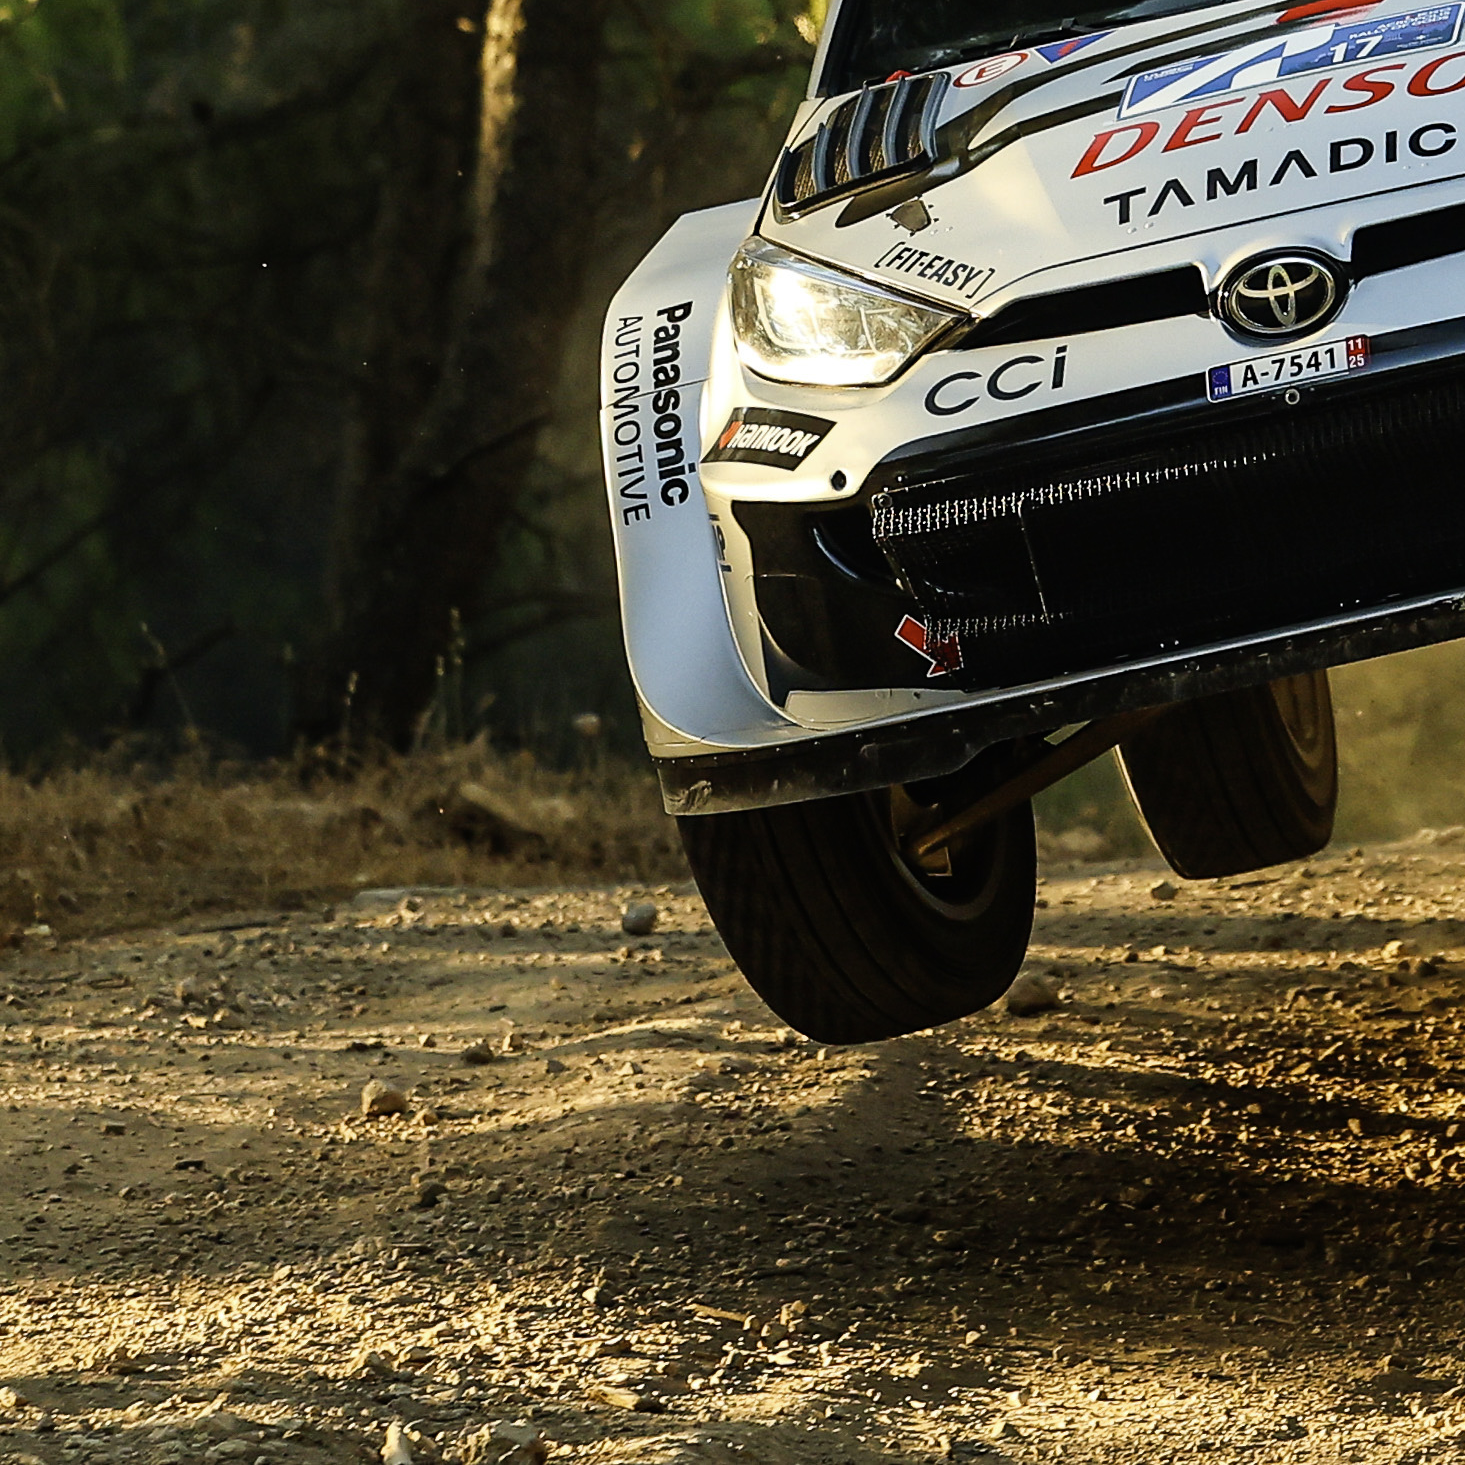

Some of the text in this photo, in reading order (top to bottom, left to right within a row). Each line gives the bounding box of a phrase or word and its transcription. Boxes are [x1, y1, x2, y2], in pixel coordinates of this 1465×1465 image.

[1331, 35, 1382, 63] 17
[1103, 122, 1458, 225] TAMADIC
[1347, 337, 1363, 351] 11
[1348, 354, 1365, 368] 25
[1241, 348, 1336, 388] A-7541
[612, 316, 652, 528] AUTOMOTIVE
[651, 300, 698, 508] Panasonic
